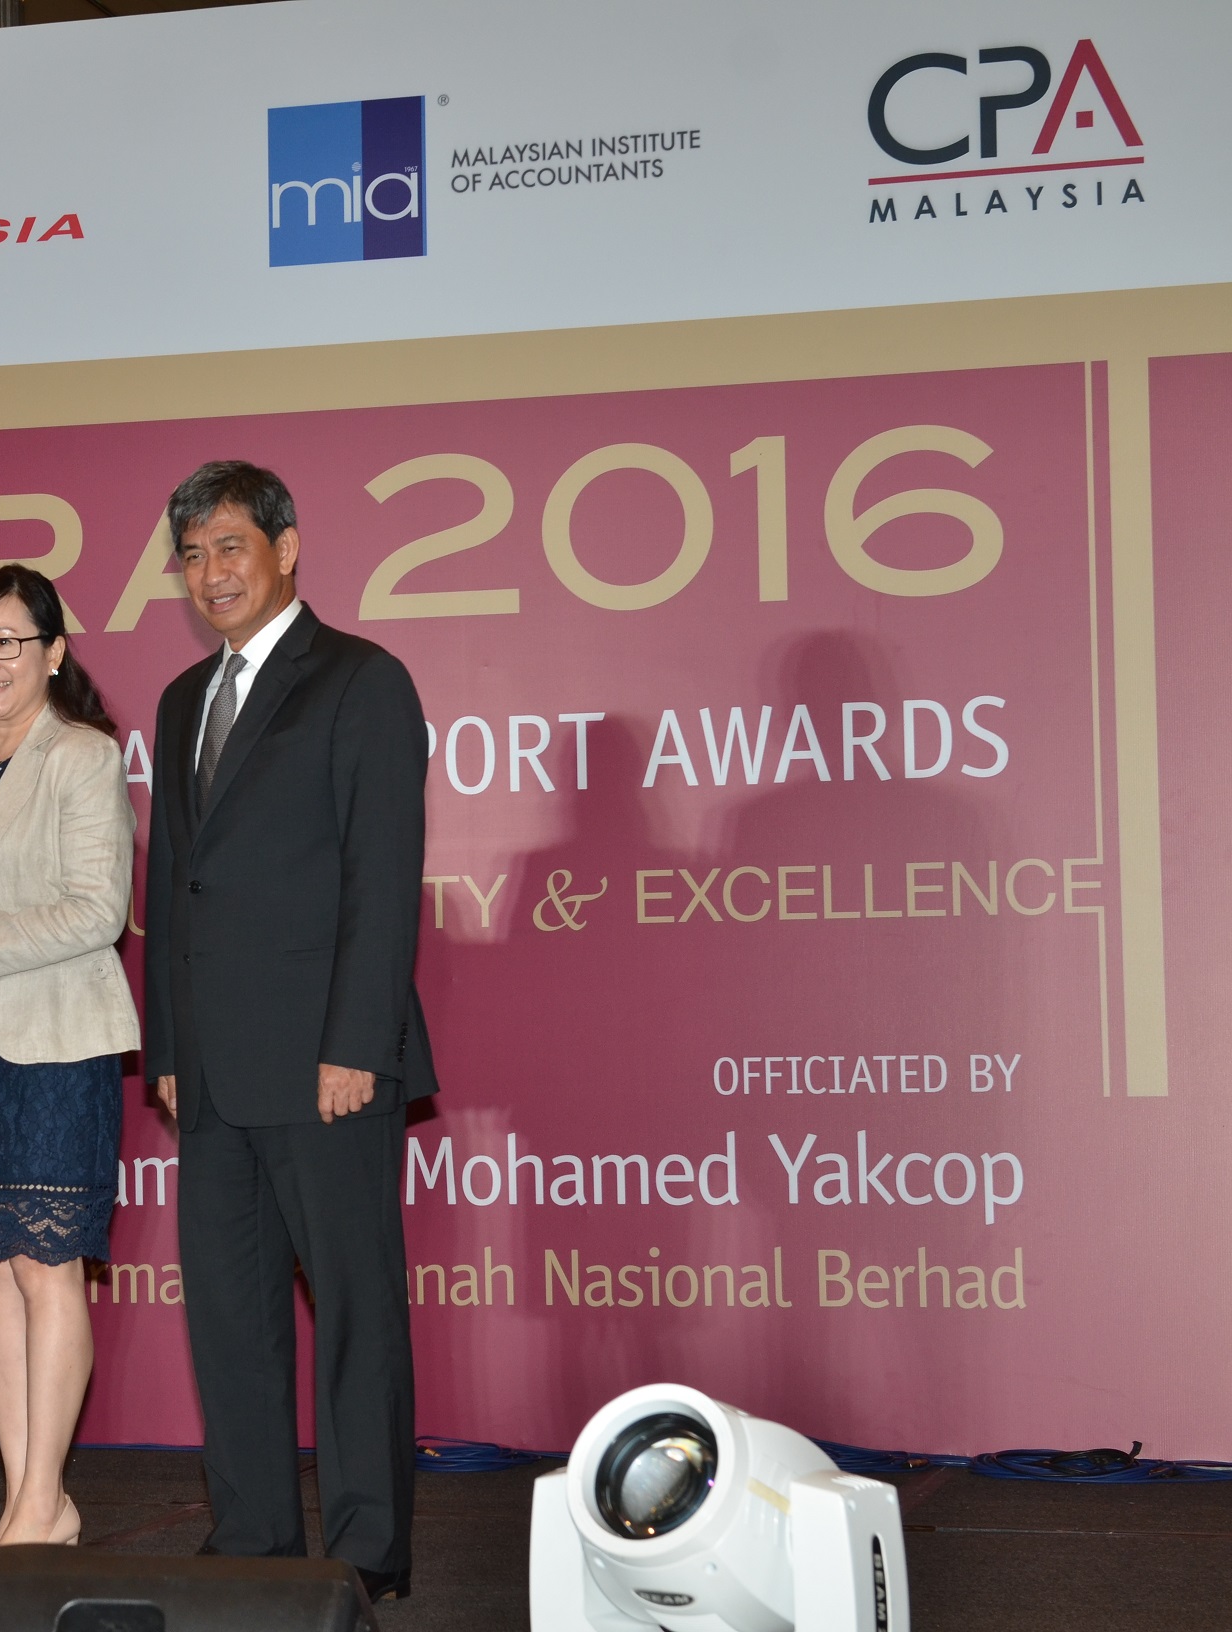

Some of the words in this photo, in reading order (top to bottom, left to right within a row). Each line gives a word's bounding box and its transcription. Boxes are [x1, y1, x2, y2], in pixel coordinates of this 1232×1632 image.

[867, 38, 1145, 166] CPA
[404, 165, 418, 173] 1967
[450, 139, 583, 168] MALAYSIAN
[591, 129, 702, 158] INSTITUTE
[451, 173, 483, 194] OF
[488, 158, 665, 192] ACCOUNTANTS
[271, 161, 419, 229] mia
[868, 177, 1146, 225] MALAYSIA
[358, 424, 1005, 622] 2016
[642, 695, 1012, 789] AWARDS
[532, 868, 609, 932] &
[636, 857, 1103, 925] EXCELLENCE
[712, 1055, 949, 1097] OFFICIATED
[970, 1054, 1022, 1094] BY
[405, 1130, 741, 1208] Mohamed
[767, 1130, 1026, 1226] Yakcop
[544, 1247, 794, 1311] Nasional
[817, 1246, 1028, 1311] Berhad
